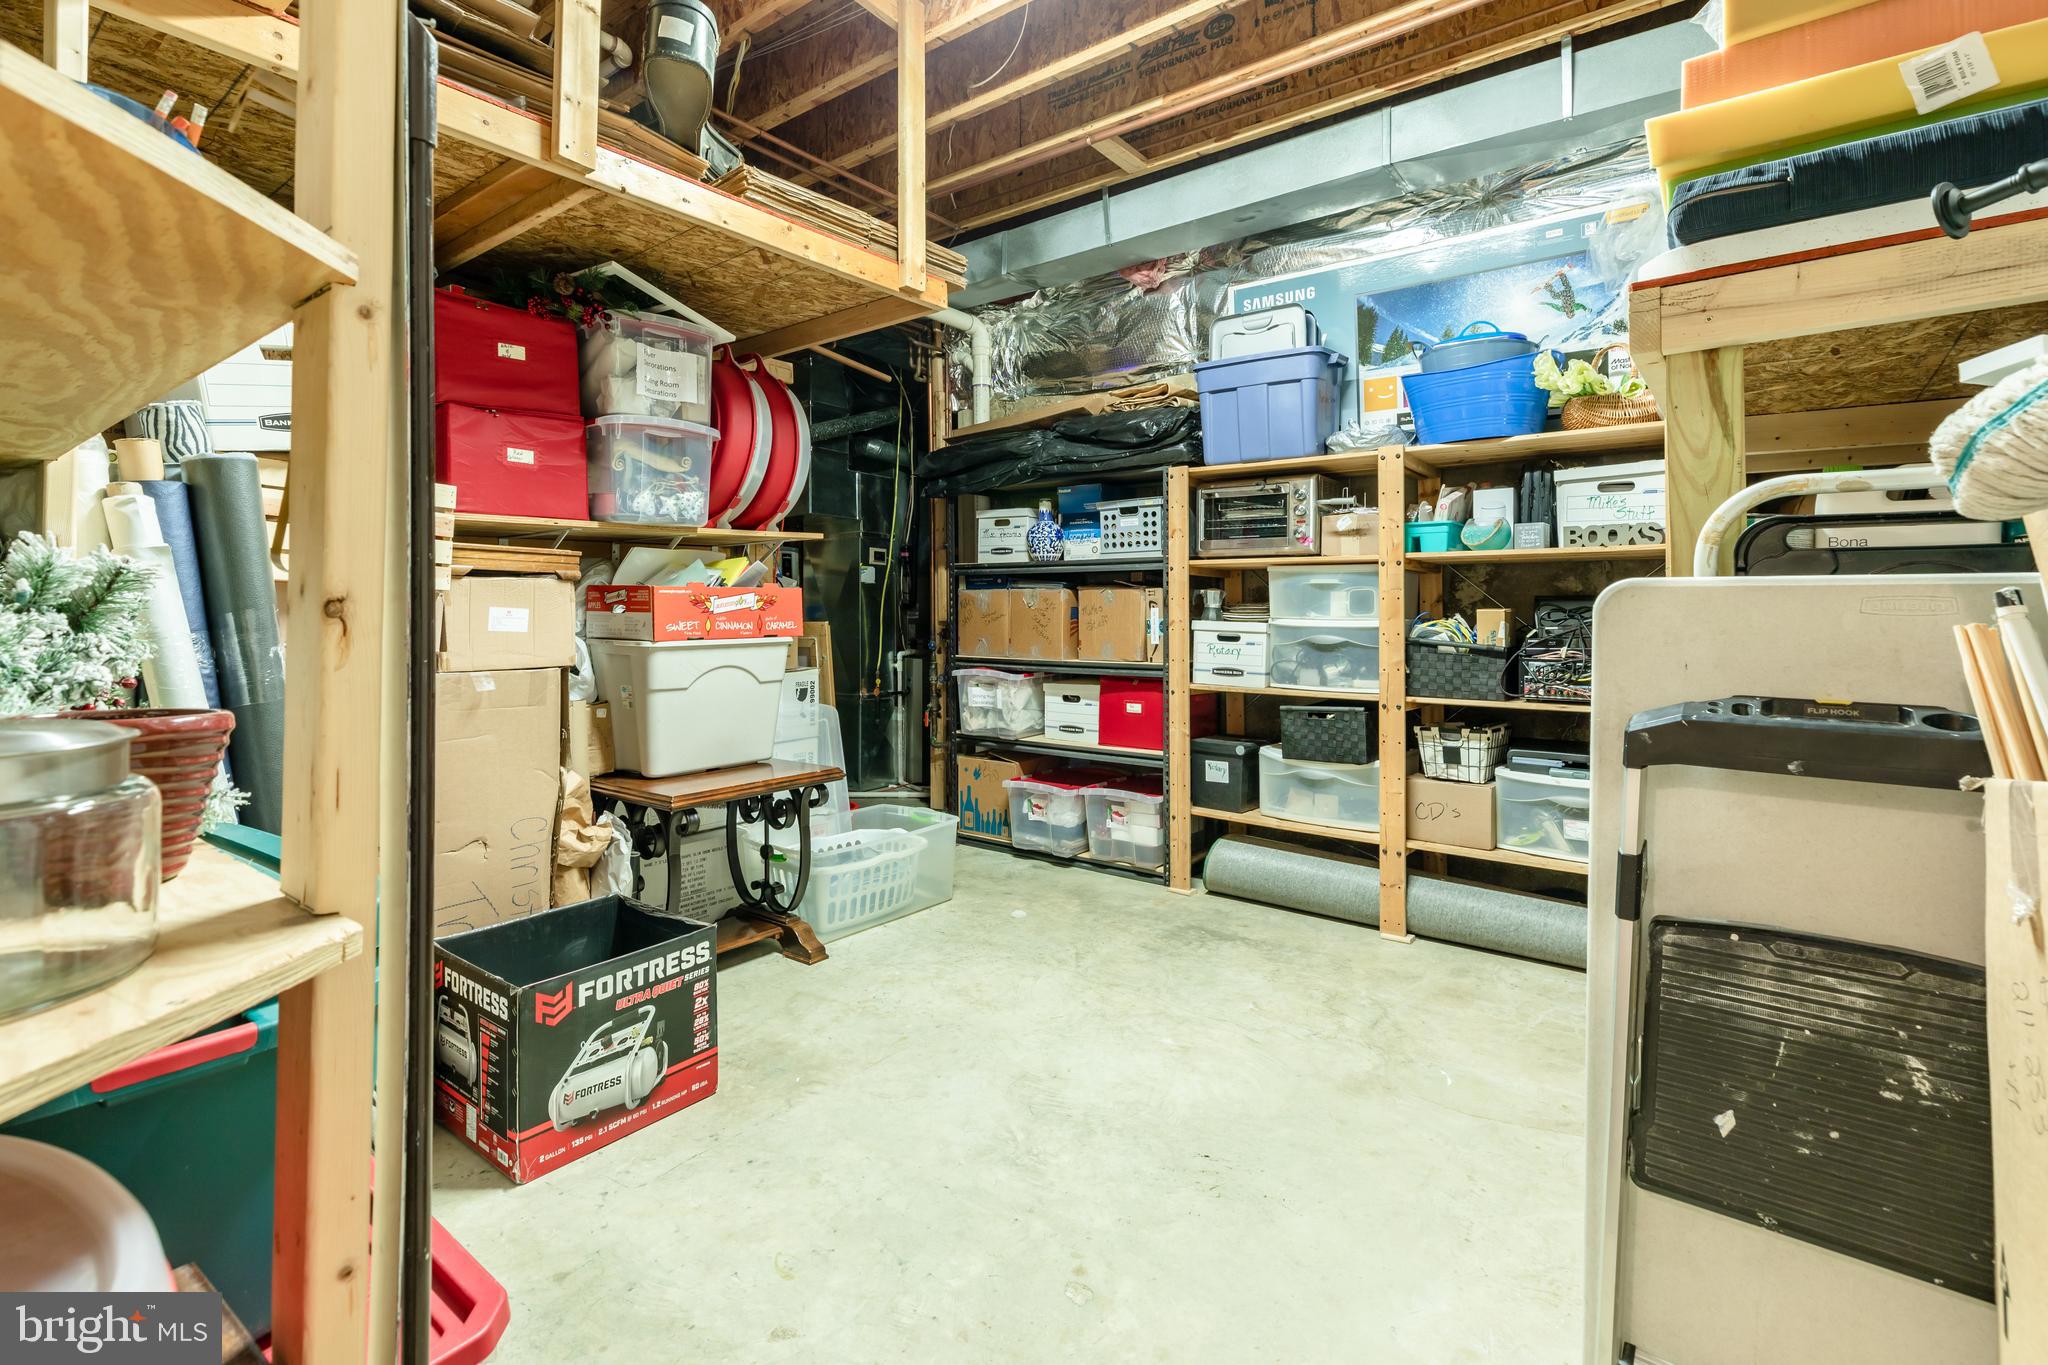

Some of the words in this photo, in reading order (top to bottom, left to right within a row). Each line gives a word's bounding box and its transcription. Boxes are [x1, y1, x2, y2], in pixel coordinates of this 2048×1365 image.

[1209, 35, 1235, 53] PLUS
[1265, 81, 1289, 99] PLUS
[1243, 286, 1316, 312] SAMSUNG
[660, 379, 680, 389] Room
[1587, 495, 1627, 509] Mike's
[1613, 505, 1655, 520] Stuff
[1563, 522, 1666, 547] BOOKS
[1828, 536, 1868, 548] Bona
[665, 620, 700, 632] SWEET
[715, 621, 753, 630] CINNAMON
[765, 620, 797, 630] CARAMEL
[1207, 643, 1242, 660] Rotary
[1807, 707, 1828, 715] FLIP
[1830, 708, 1860, 716] HOOK
[1415, 801, 1461, 820] CD's
[578, 940, 710, 1008] FORTRESS
[444, 966, 508, 1021] FORTRESS
[615, 988, 651, 1011] ULTRA
[652, 976, 684, 999] QUIET
[684, 966, 710, 981] SERIES
[445, 1037, 468, 1059] FORTRESS
[575, 1075, 622, 1099] FORTRESS
[539, 1155, 545, 1163] 2
[545, 1147, 566, 1161] GALLON
[571, 1136, 584, 1148] 135
[584, 1135, 593, 1143] PSI
[598, 1126, 608, 1136] 2.1
[608, 1117, 627, 1131] SCFM
[652, 1100, 661, 1110] 1.2
